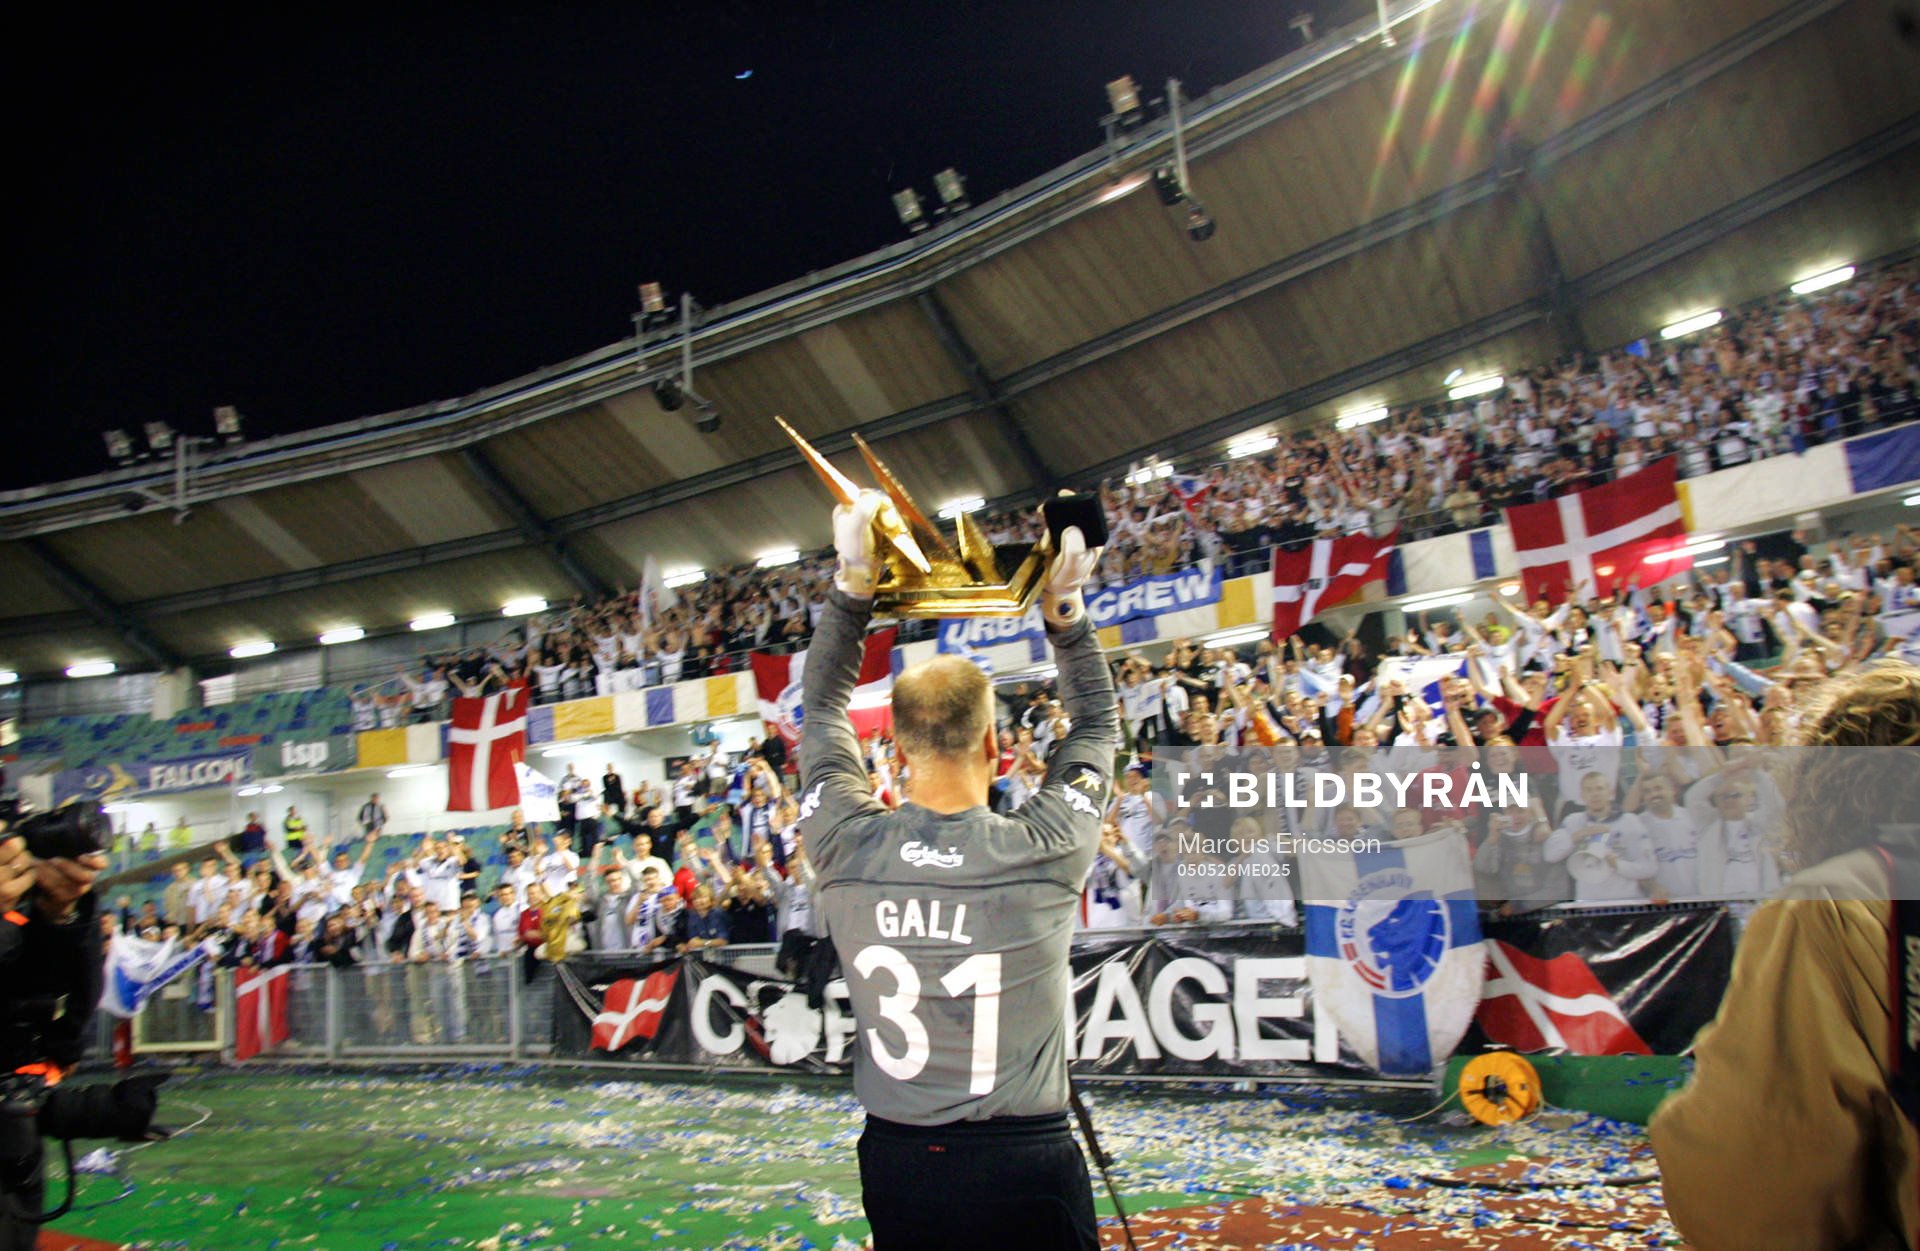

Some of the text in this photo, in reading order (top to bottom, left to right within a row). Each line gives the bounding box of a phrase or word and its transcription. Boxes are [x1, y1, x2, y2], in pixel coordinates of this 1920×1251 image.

[944, 572, 1213, 646] URBA CREW
[281, 739, 328, 768] isp
[875, 898, 973, 945] GALL
[853, 944, 1002, 1095] 31
